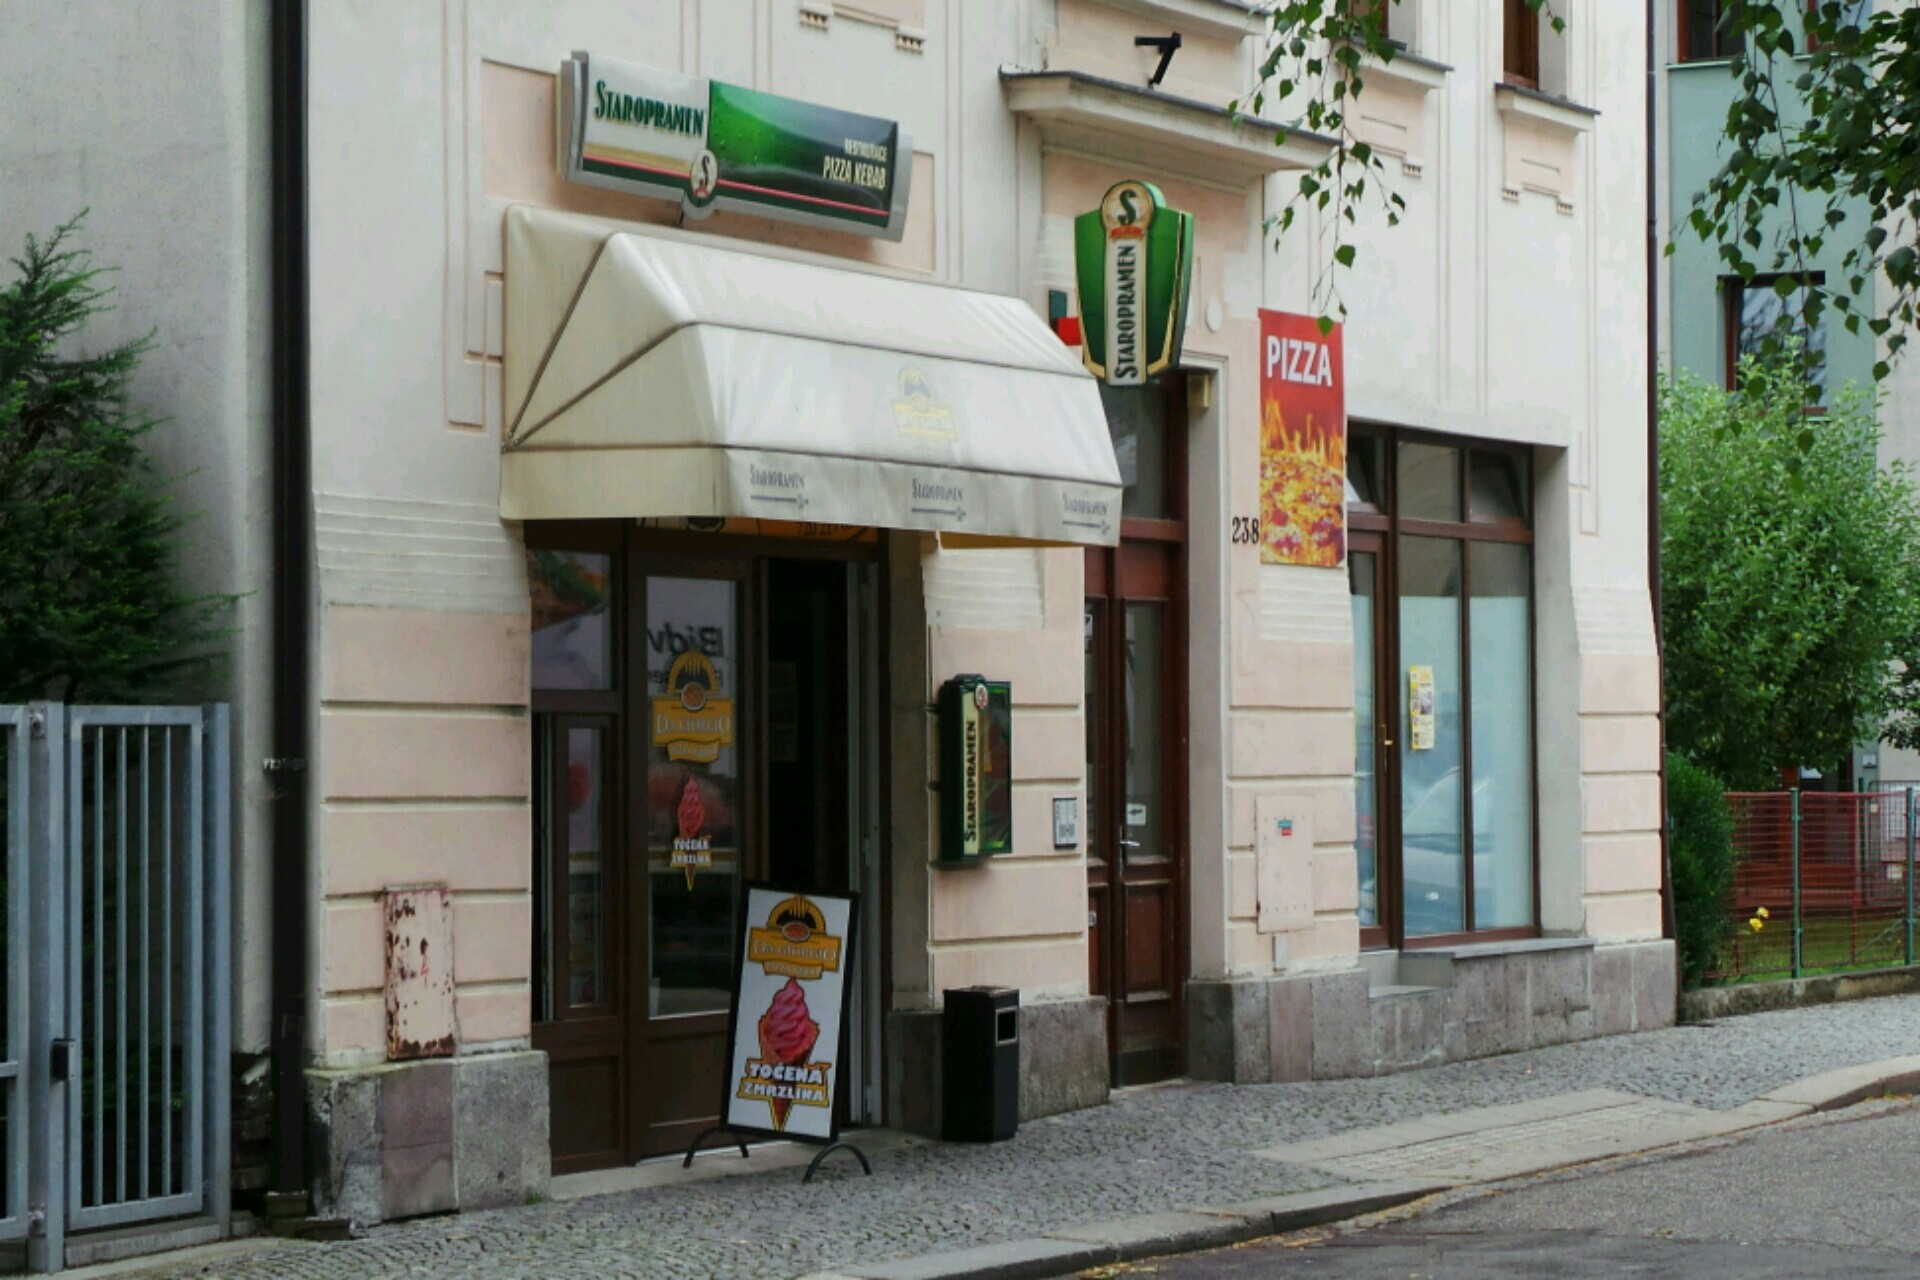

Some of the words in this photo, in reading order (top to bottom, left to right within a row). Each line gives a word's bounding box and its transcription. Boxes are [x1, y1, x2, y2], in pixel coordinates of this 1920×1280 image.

[594, 79, 704, 137] STAROPRAMEN
[823, 155, 852, 183] PIZZA
[1118, 189, 1138, 226] S
[1114, 245, 1138, 379] STAROPRAMEN
[1266, 335, 1333, 387] PIZZA
[1232, 516, 1260, 544] 238
[964, 720, 977, 842] STAROPRAMEN
[744, 1082, 823, 1102] ZMRZLINA
